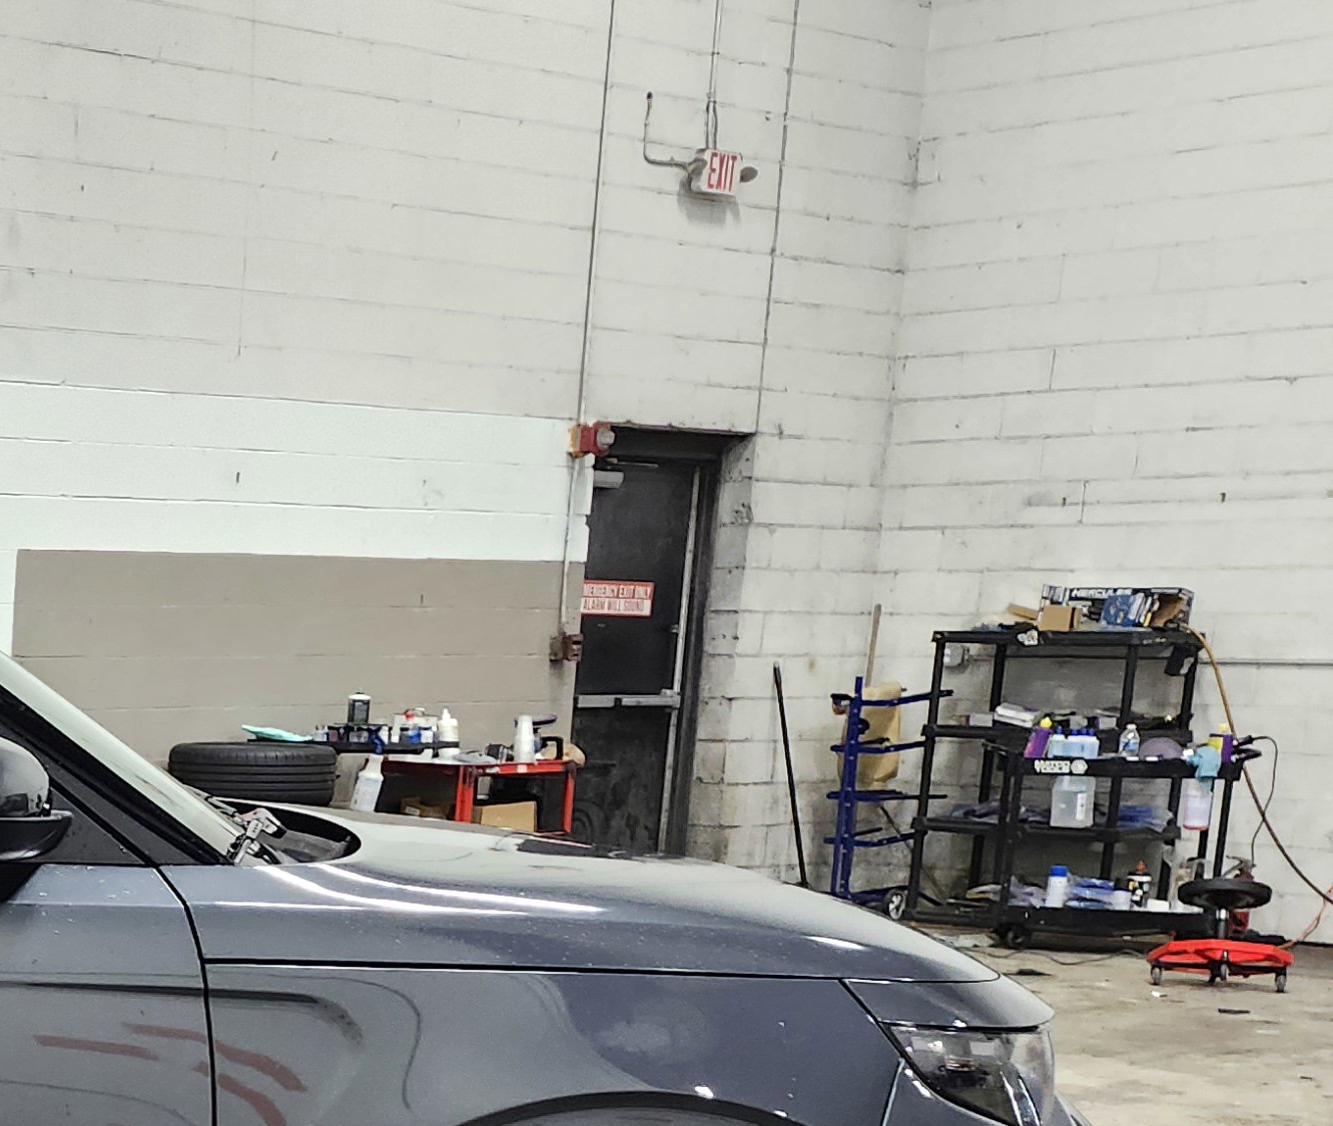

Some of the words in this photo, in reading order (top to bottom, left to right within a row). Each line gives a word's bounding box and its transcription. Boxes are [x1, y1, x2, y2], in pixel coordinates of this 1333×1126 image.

[707, 151, 738, 193] EXIT
[583, 584, 616, 597] MERGENCY
[619, 585, 635, 598] EXIT
[583, 599, 606, 610] ALARM
[607, 600, 621, 611] WILL
